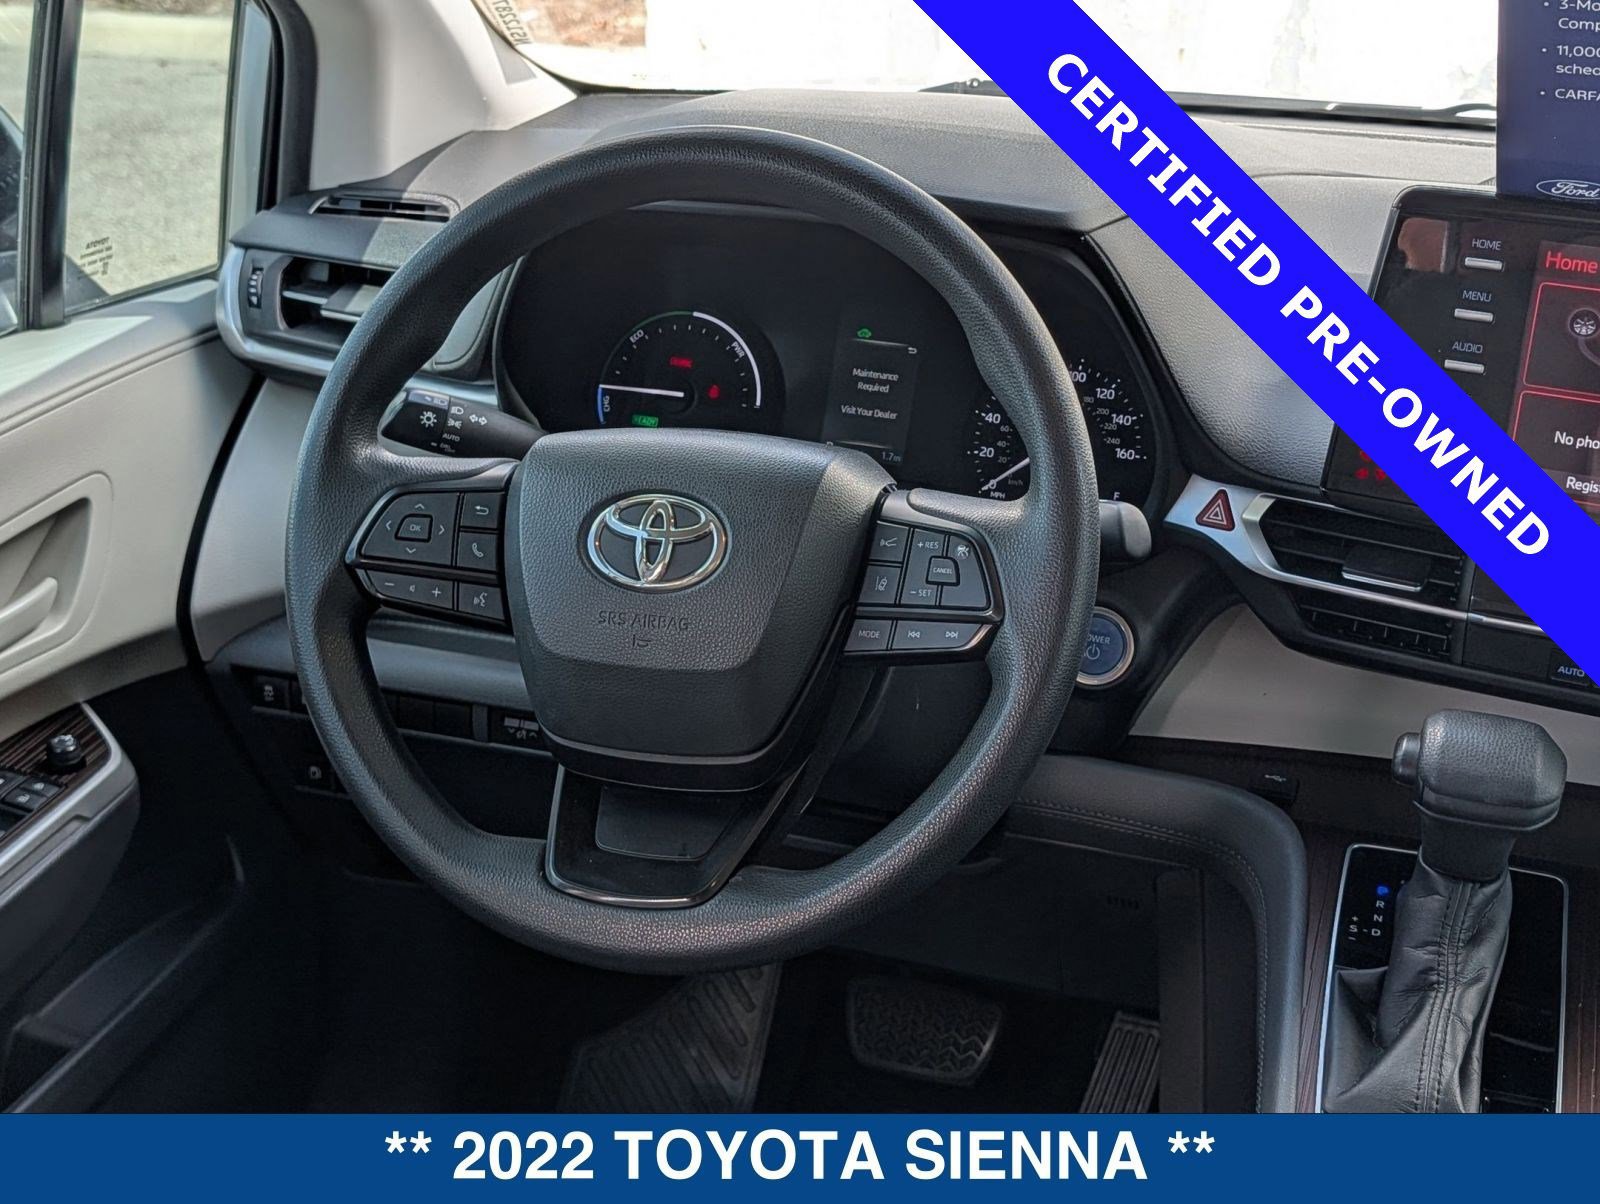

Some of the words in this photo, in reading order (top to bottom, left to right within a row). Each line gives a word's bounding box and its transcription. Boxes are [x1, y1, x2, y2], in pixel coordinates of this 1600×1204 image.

[1551, 181, 1600, 198] Ford
[1472, 238, 1501, 251] HOME
[1545, 251, 1598, 274] Home
[1462, 290, 1492, 302] MENU
[629, 329, 645, 344] ECO
[731, 341, 746, 359] PWR
[1452, 341, 1483, 354] AUDIO
[852, 368, 899, 381] Maintenance
[1069, 370, 1087, 383] 00
[857, 382, 890, 393] Required
[1095, 387, 1115, 400] 120
[841, 405, 857, 415] Visit
[857, 407, 873, 417] Your
[874, 409, 898, 420] Dealer
[985, 412, 1001, 424] 40
[1111, 413, 1132, 426] 140
[442, 433, 460, 442] AUTO
[1554, 430, 1574, 446] No
[1575, 435, 1600, 450] pho
[978, 446, 995, 458] 20
[1114, 447, 1135, 460] 160
[1113, 491, 1120, 500] F
[409, 524, 421, 532] OK
[933, 566, 953, 575] CANCEL
[598, 610, 626, 626] SRS
[631, 614, 690, 631] AIRBAG
[858, 631, 881, 639] MODE
[1087, 633, 1111, 645] OWER
[1557, 665, 1585, 678] AUTO
[1375, 900, 1385, 909] R
[1373, 914, 1383, 922] N
[1348, 924, 1358, 933] S
[1371, 928, 1381, 937] D
